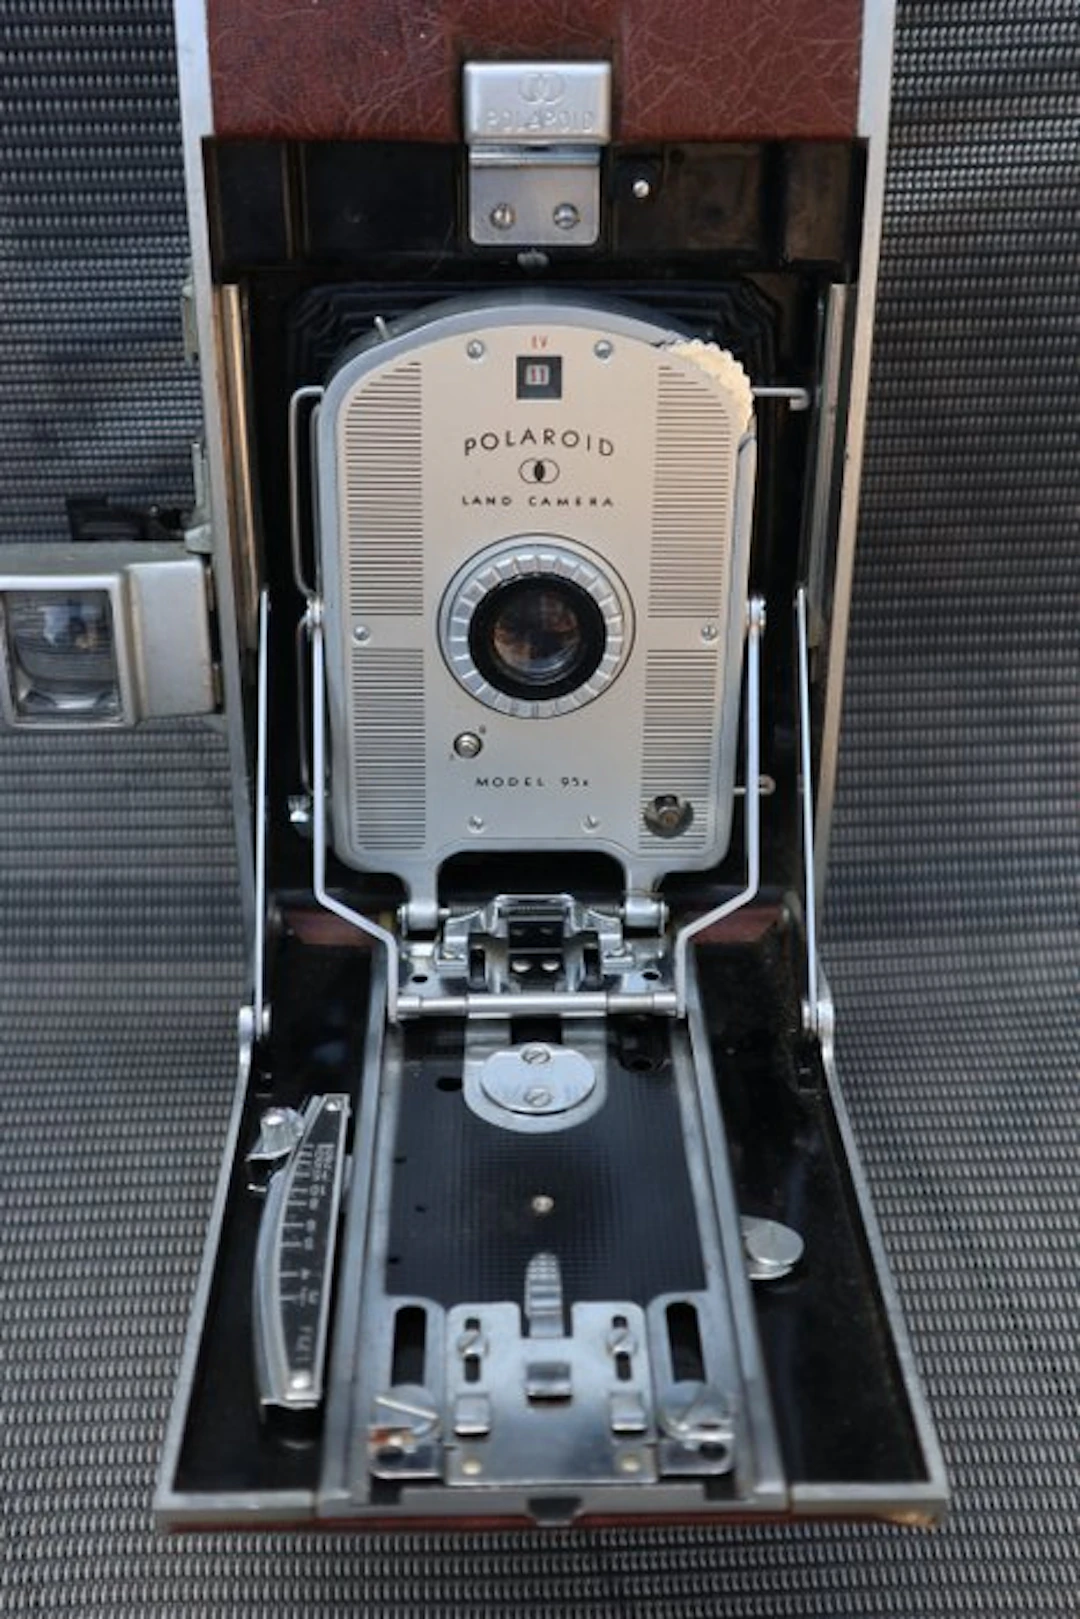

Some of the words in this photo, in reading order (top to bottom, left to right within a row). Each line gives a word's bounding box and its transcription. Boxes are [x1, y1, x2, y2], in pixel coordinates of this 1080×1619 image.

[487, 110, 595, 133] POLAROID
[464, 428, 614, 456] POLAROID
[462, 496, 513, 507] LAND
[529, 496, 614, 507] CAMERA
[476, 777, 546, 788] MODEL
